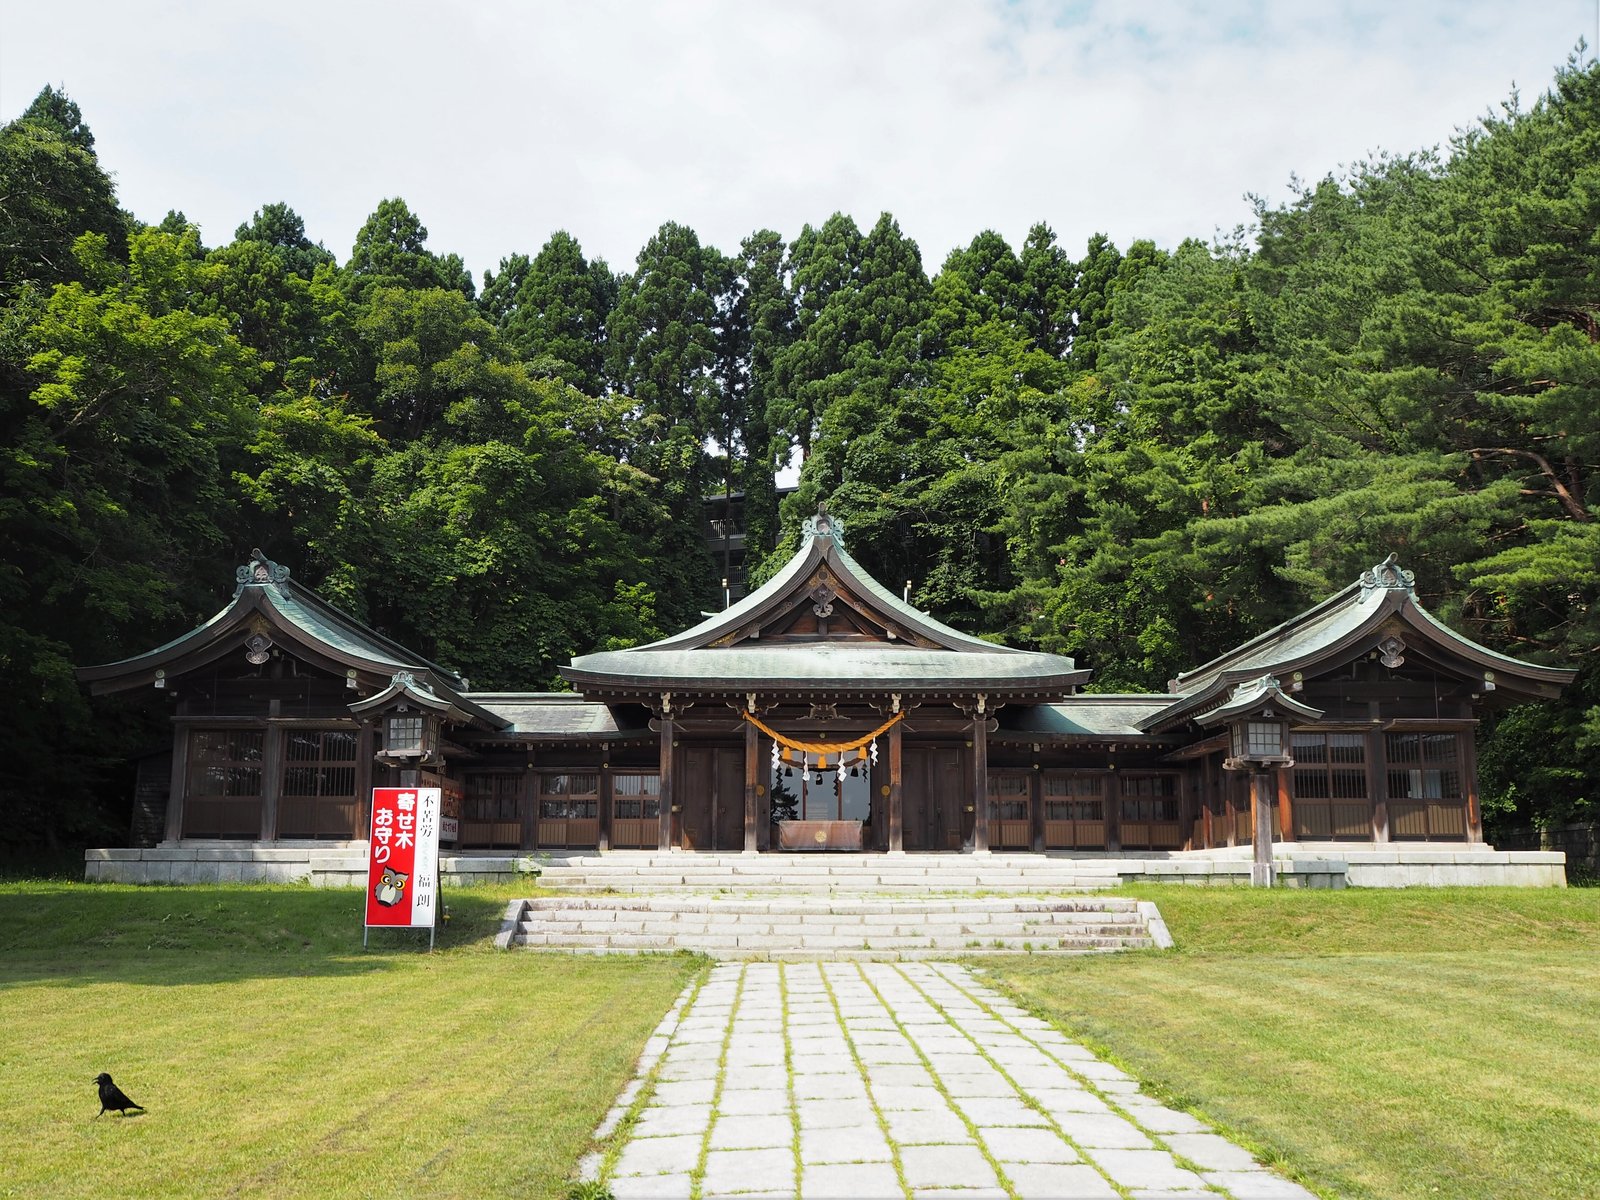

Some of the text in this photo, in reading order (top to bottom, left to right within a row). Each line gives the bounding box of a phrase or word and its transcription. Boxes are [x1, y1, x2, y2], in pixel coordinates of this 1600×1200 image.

[374, 807, 393, 864] お守り
[395, 792, 416, 849] 寄せ木
[420, 794, 434, 838] 不苦労
